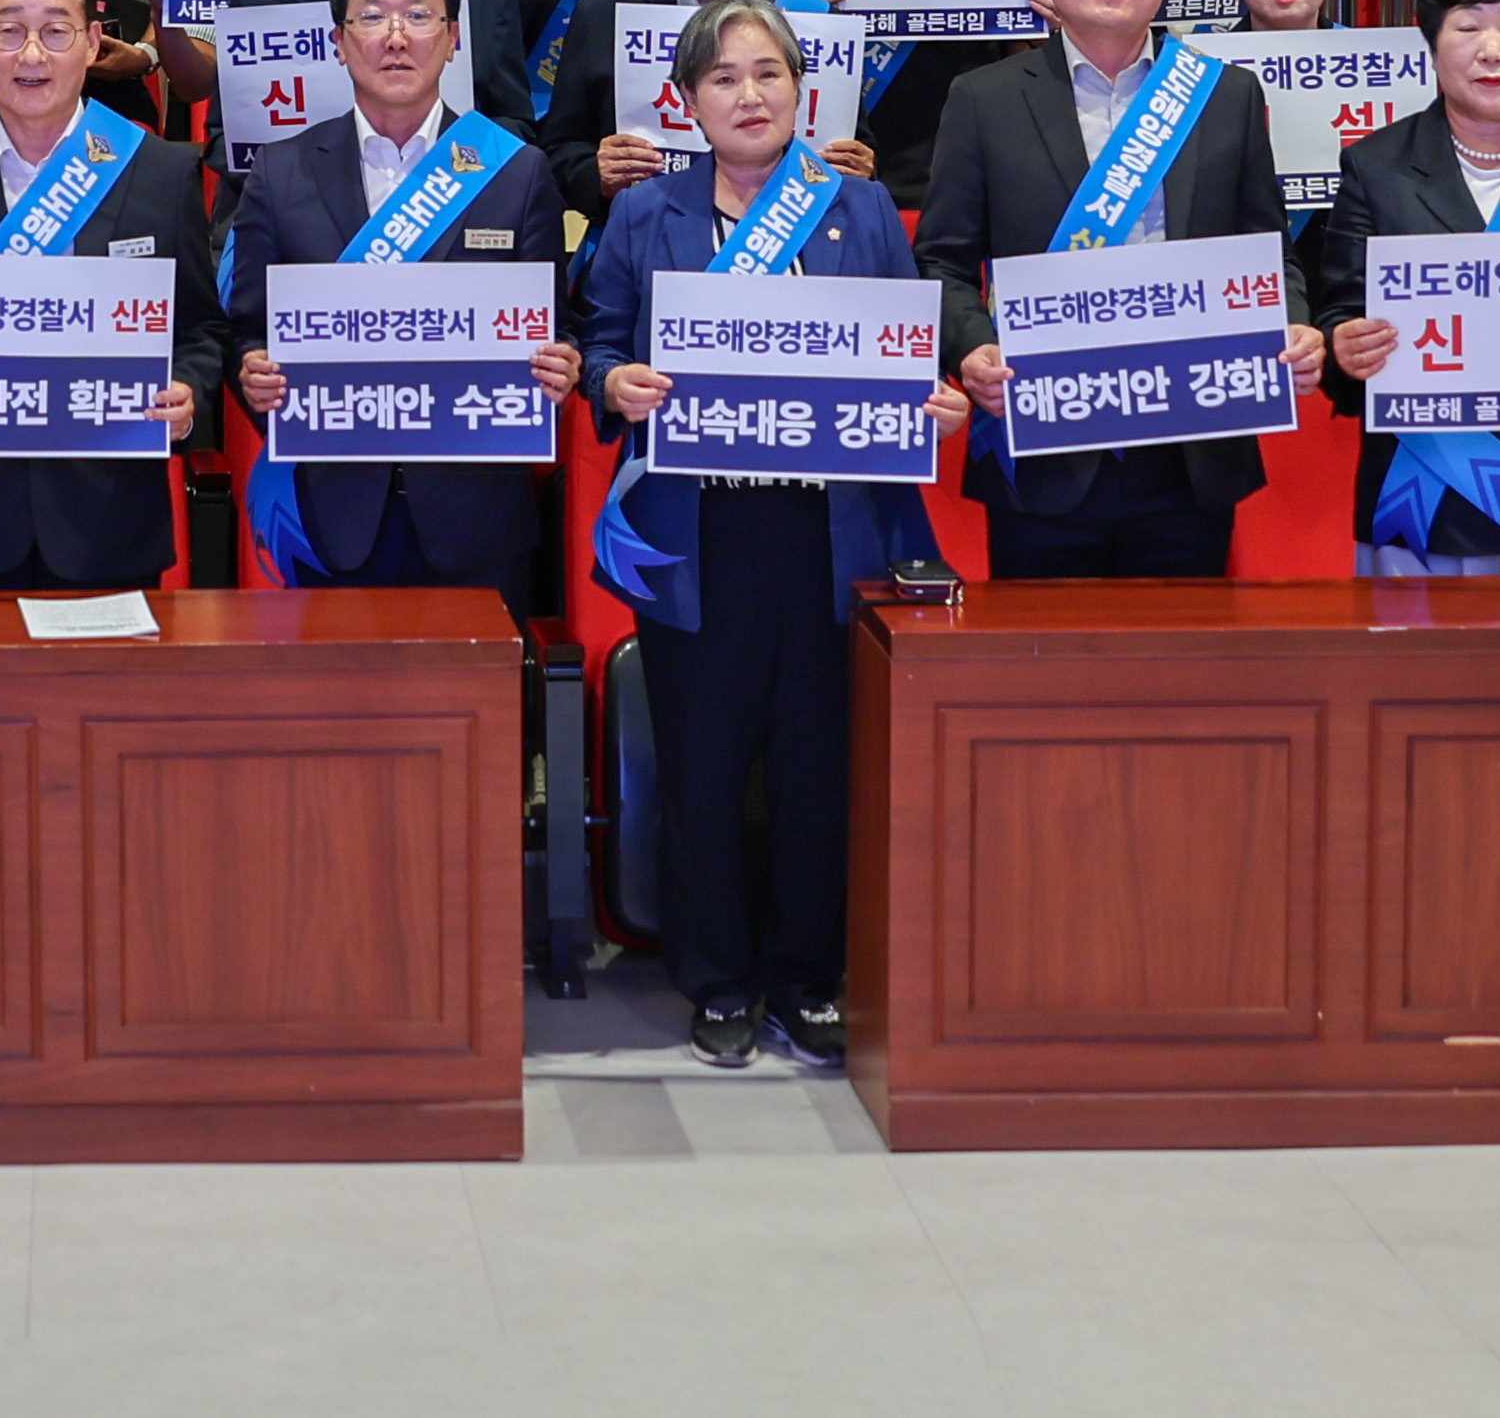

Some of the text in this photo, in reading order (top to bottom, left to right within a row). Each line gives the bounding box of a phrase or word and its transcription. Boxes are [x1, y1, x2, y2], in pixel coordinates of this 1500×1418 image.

[906, 10, 1035, 32] 골든타임 확보
[260, 76, 307, 127] 신
[1083, 49, 1208, 228] 진도해양경찰서
[111, 298, 168, 333] 신설
[274, 306, 549, 343] 진도해양경찰서 신설
[1003, 272, 1281, 331] 진도해양경찰서 신설
[658, 317, 934, 358] 진도해양경찰서 신설
[1413, 314, 1464, 372] 신
[67, 379, 161, 426] 확보!
[280, 383, 544, 431] 서남해안 수호!
[1014, 355, 1281, 423] 해양치안 강화!
[1385, 397, 1462, 423] 서남해
[661, 396, 931, 450] 신속대응 강화!
